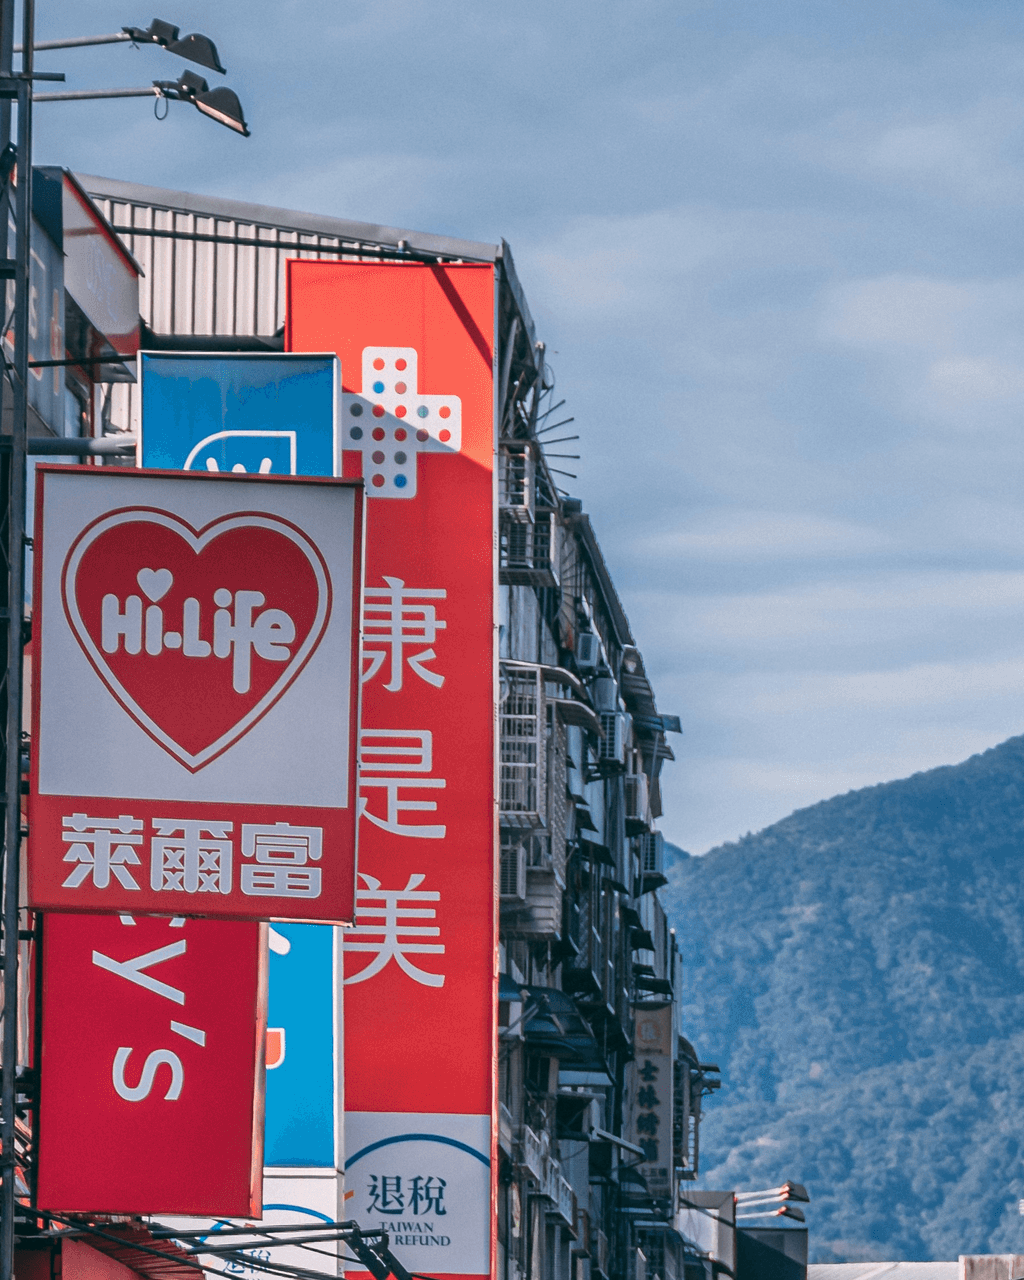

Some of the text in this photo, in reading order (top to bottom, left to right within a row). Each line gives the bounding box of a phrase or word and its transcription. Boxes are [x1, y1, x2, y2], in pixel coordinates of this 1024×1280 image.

[102, 568, 296, 694] Hi-Life
[343, 575, 447, 988] 康是美
[62, 813, 323, 898] 萊爾富
[92, 915, 206, 1102] Y'S
[366, 1174, 447, 1215] 退稅
[379, 1221, 434, 1233] TAIWAN
[394, 1234, 451, 1246] REFUND
